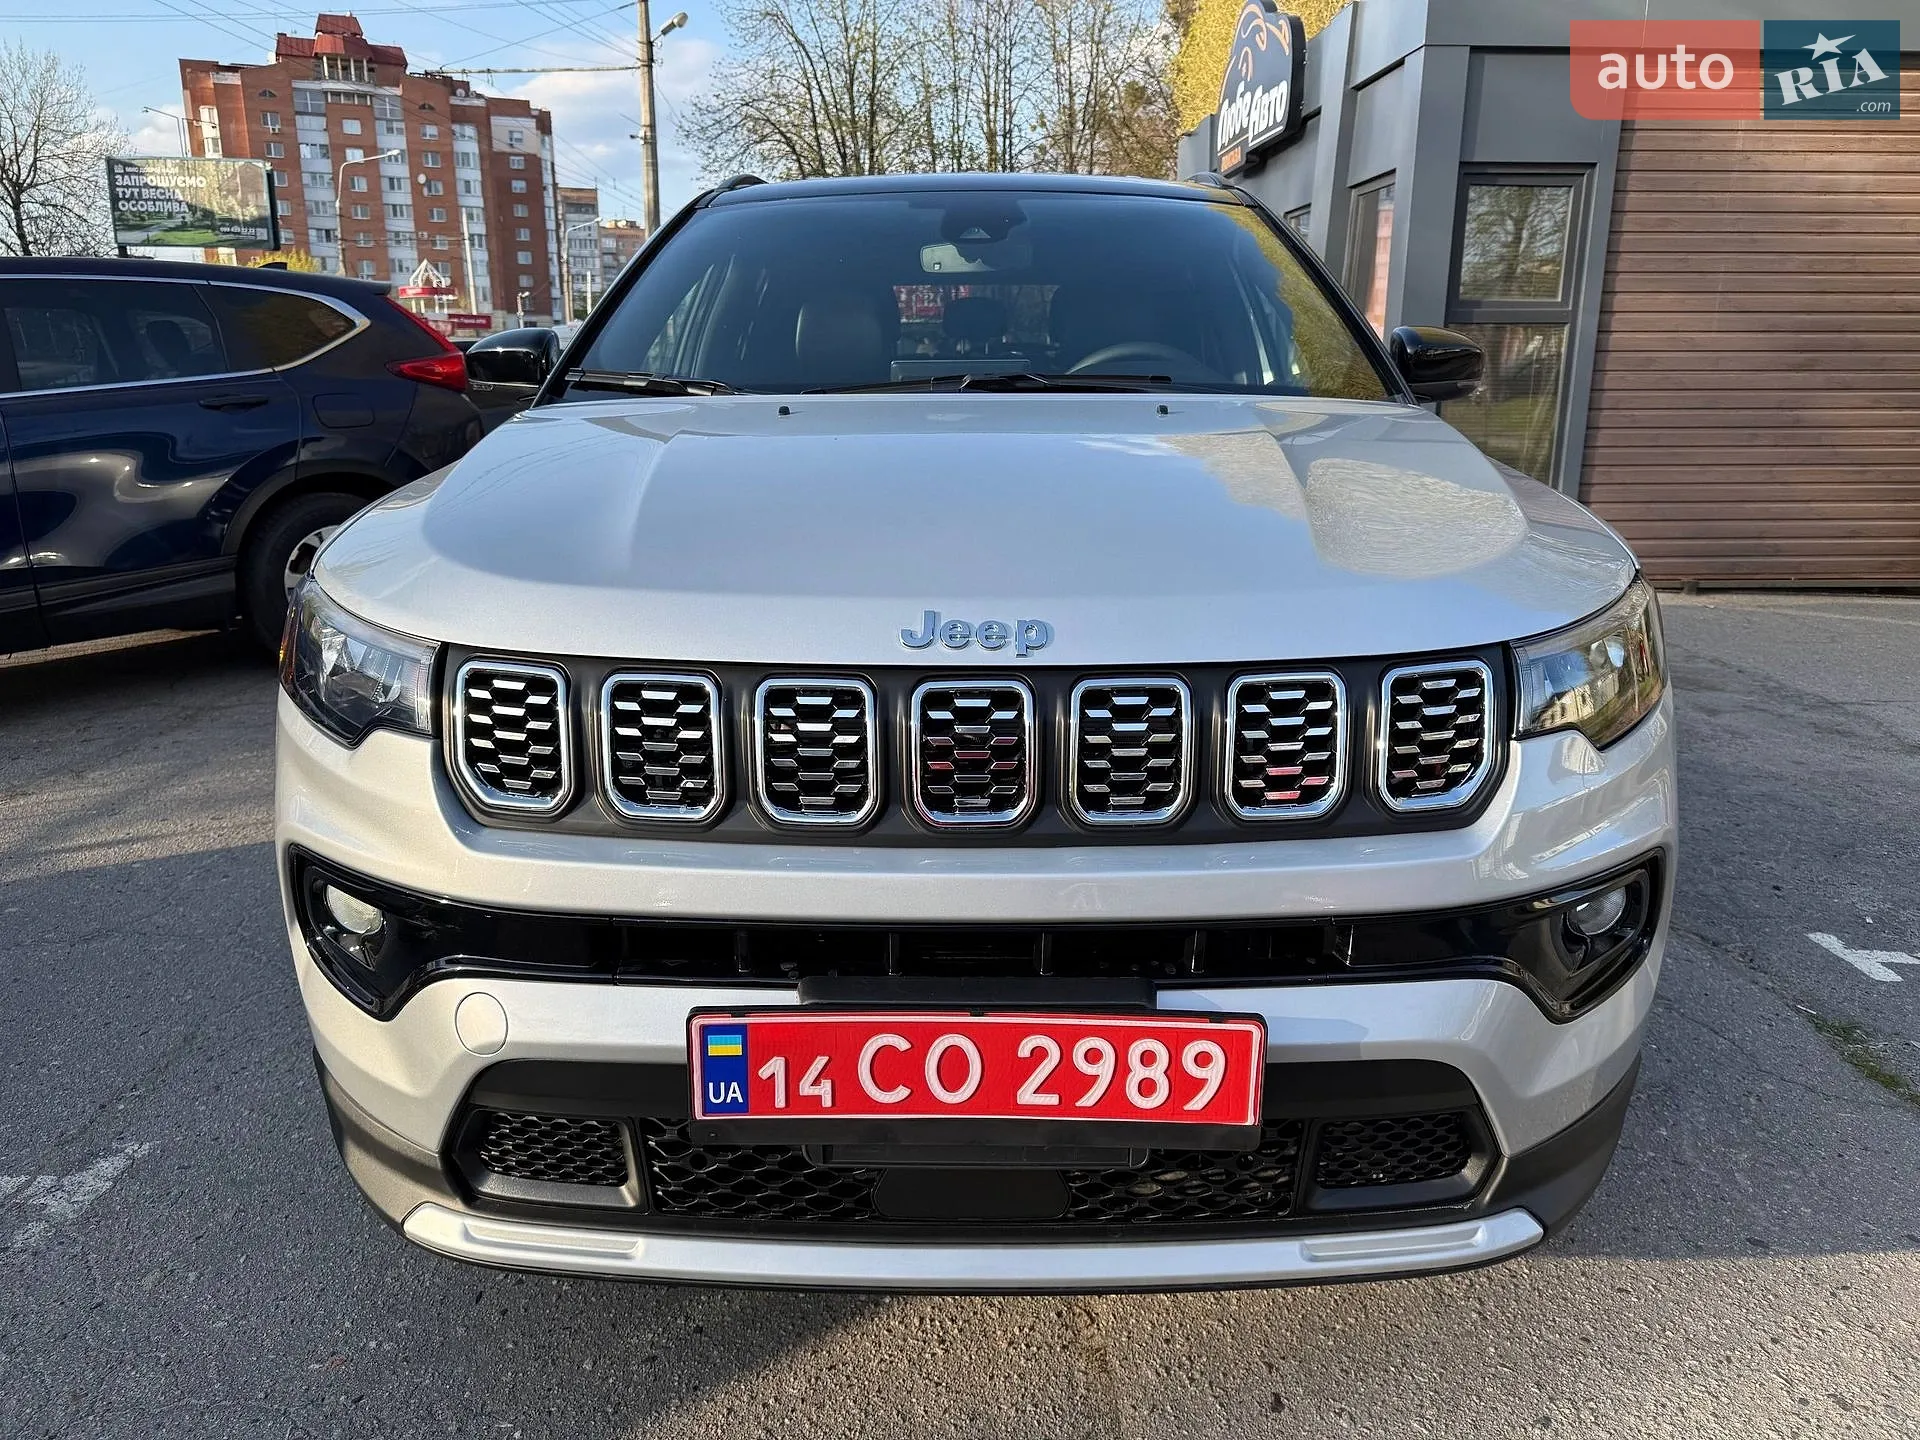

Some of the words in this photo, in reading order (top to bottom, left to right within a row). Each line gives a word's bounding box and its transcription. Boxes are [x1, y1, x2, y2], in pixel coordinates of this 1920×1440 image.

[114, 175, 207, 188] ЗАПРОШУЄМО
[116, 188, 140, 199] ТУТ
[142, 188, 185, 201] ВЕСНА
[118, 200, 189, 213] ОСОБЛИВА
[900, 610, 1049, 658] Jeep
[757, 1055, 832, 1109] 14
[857, 1033, 983, 1105] CO
[1016, 1034, 1226, 1112] 2989
[708, 1081, 743, 1104] UA
